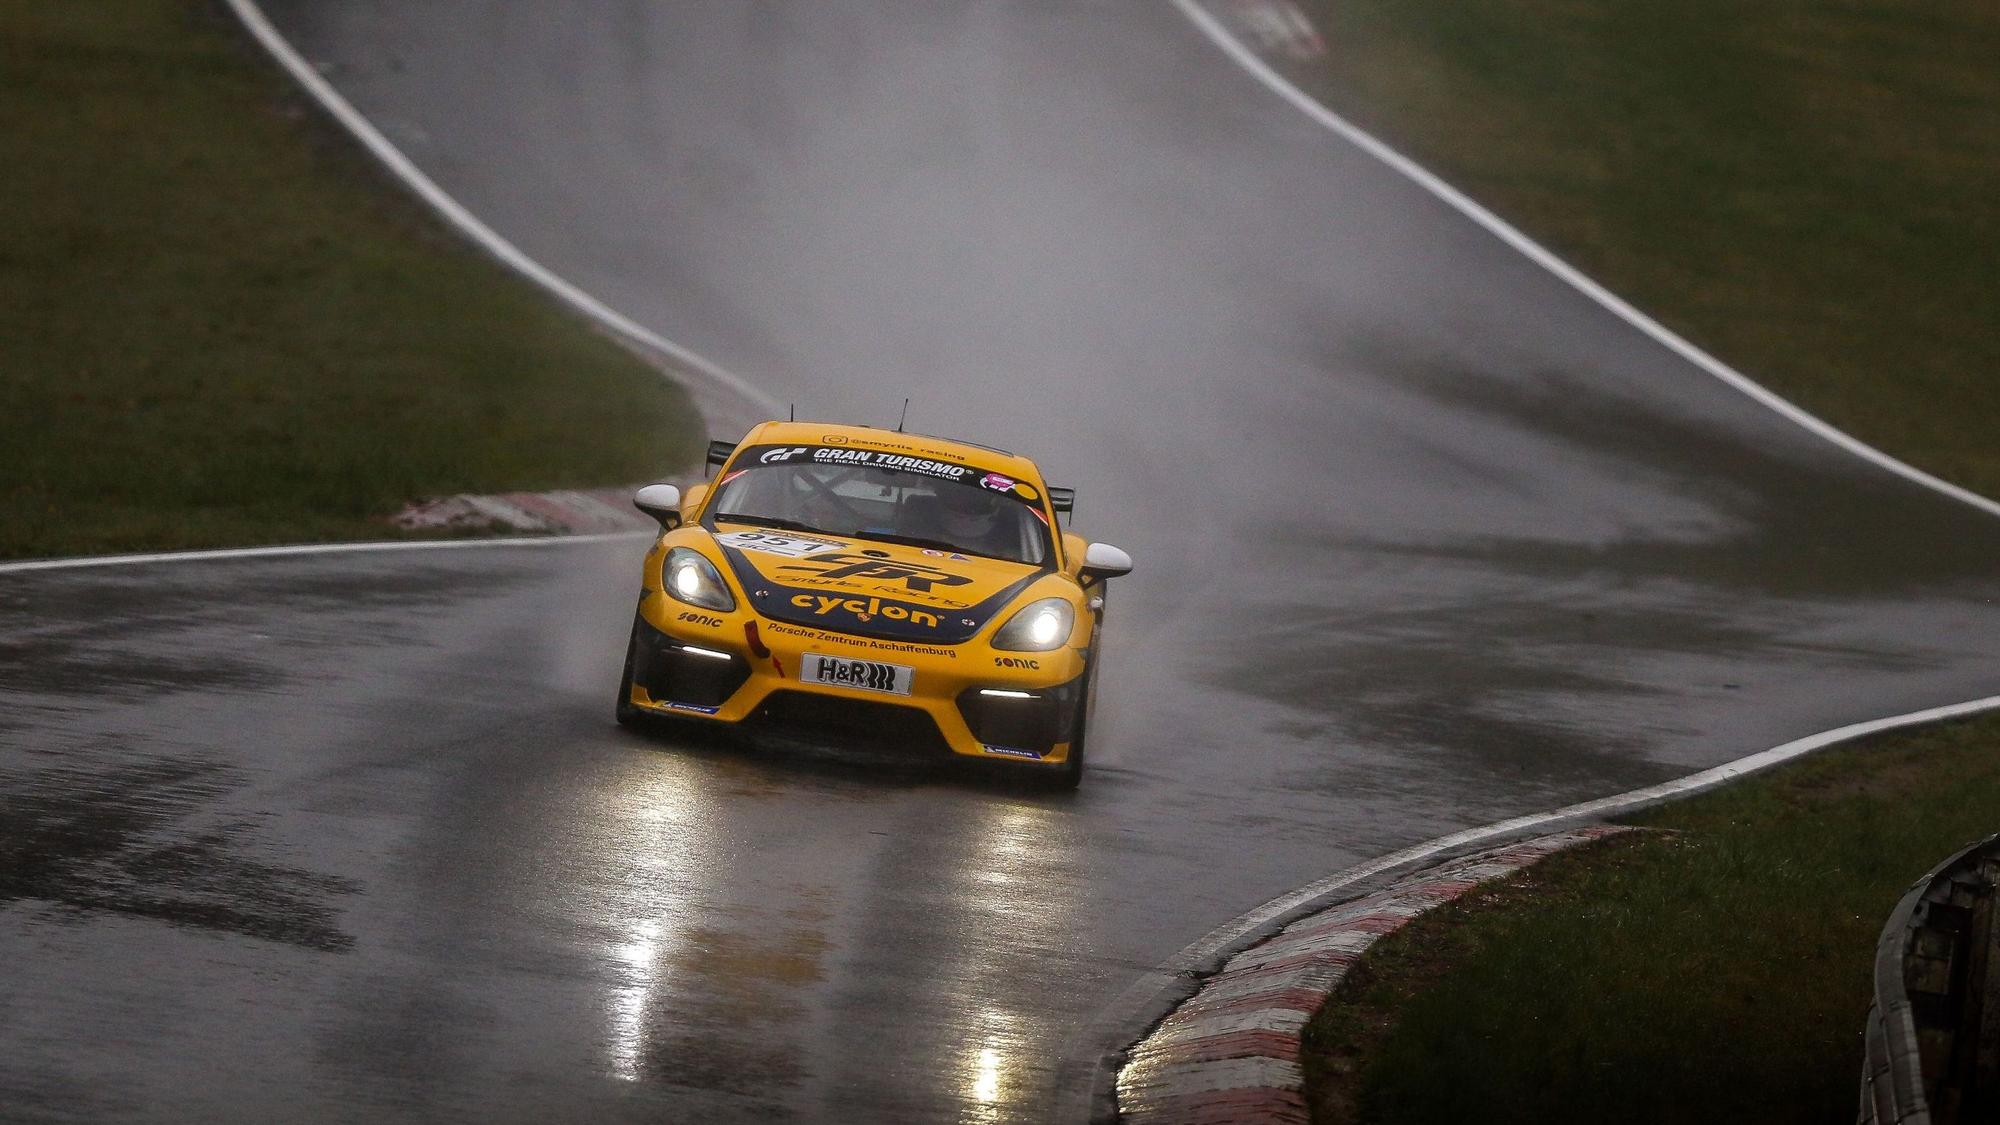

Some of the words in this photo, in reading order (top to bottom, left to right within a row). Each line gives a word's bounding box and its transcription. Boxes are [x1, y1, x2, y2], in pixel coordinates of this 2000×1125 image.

[813, 448, 870, 461] GRAN
[834, 458, 859, 466] REAL
[862, 461, 902, 471] DRIVING
[904, 467, 960, 481] SIMULATOR
[736, 533, 824, 552] 951
[791, 594, 939, 628] cyclon
[767, 622, 815, 639] Porsche
[816, 631, 868, 648] Zentrum
[869, 641, 957, 658] Aschaffenburg
[817, 657, 869, 688] H&R
